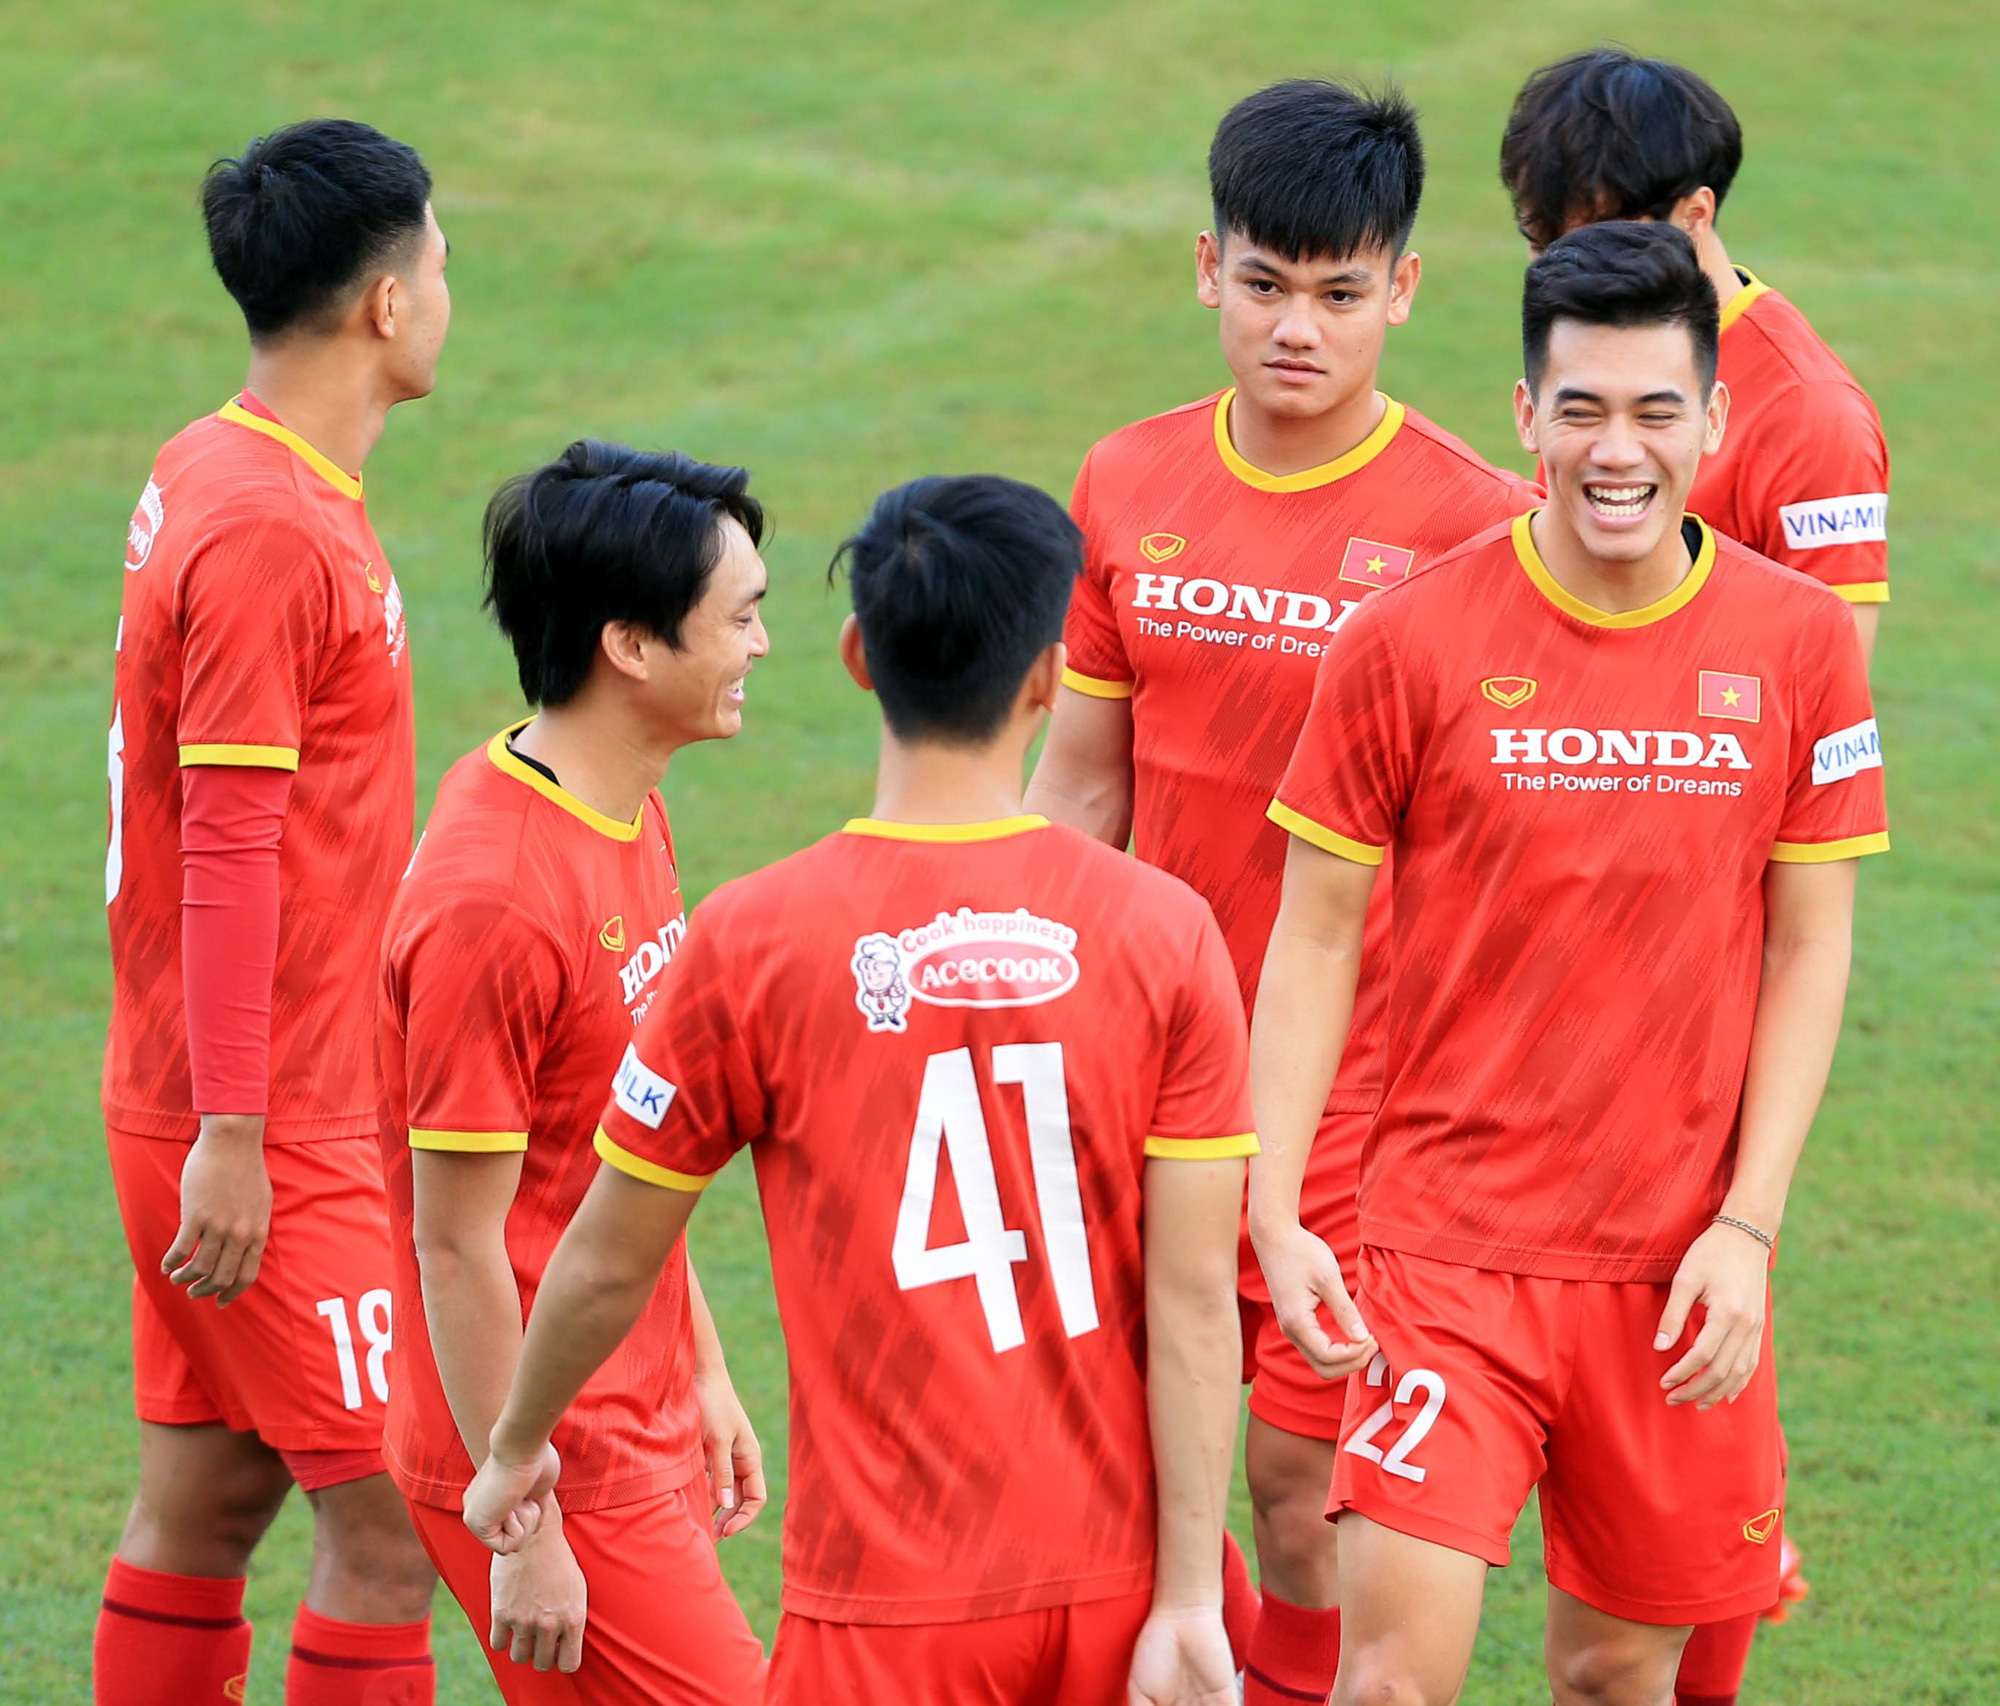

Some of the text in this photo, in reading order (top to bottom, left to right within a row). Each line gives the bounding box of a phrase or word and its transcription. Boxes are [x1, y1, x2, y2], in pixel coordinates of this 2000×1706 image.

[1136, 617, 1173, 637] The
[1176, 621, 1248, 647] Power
[1251, 634, 1276, 650] of
[1490, 728, 1752, 769] HONDA
[1501, 773, 1742, 796] The Power of Dreams
[963, 912, 1071, 946] happiness
[891, 1042, 1100, 1354] 41
[316, 1288, 393, 1410] 18
[1343, 1350, 1446, 1483] 22
